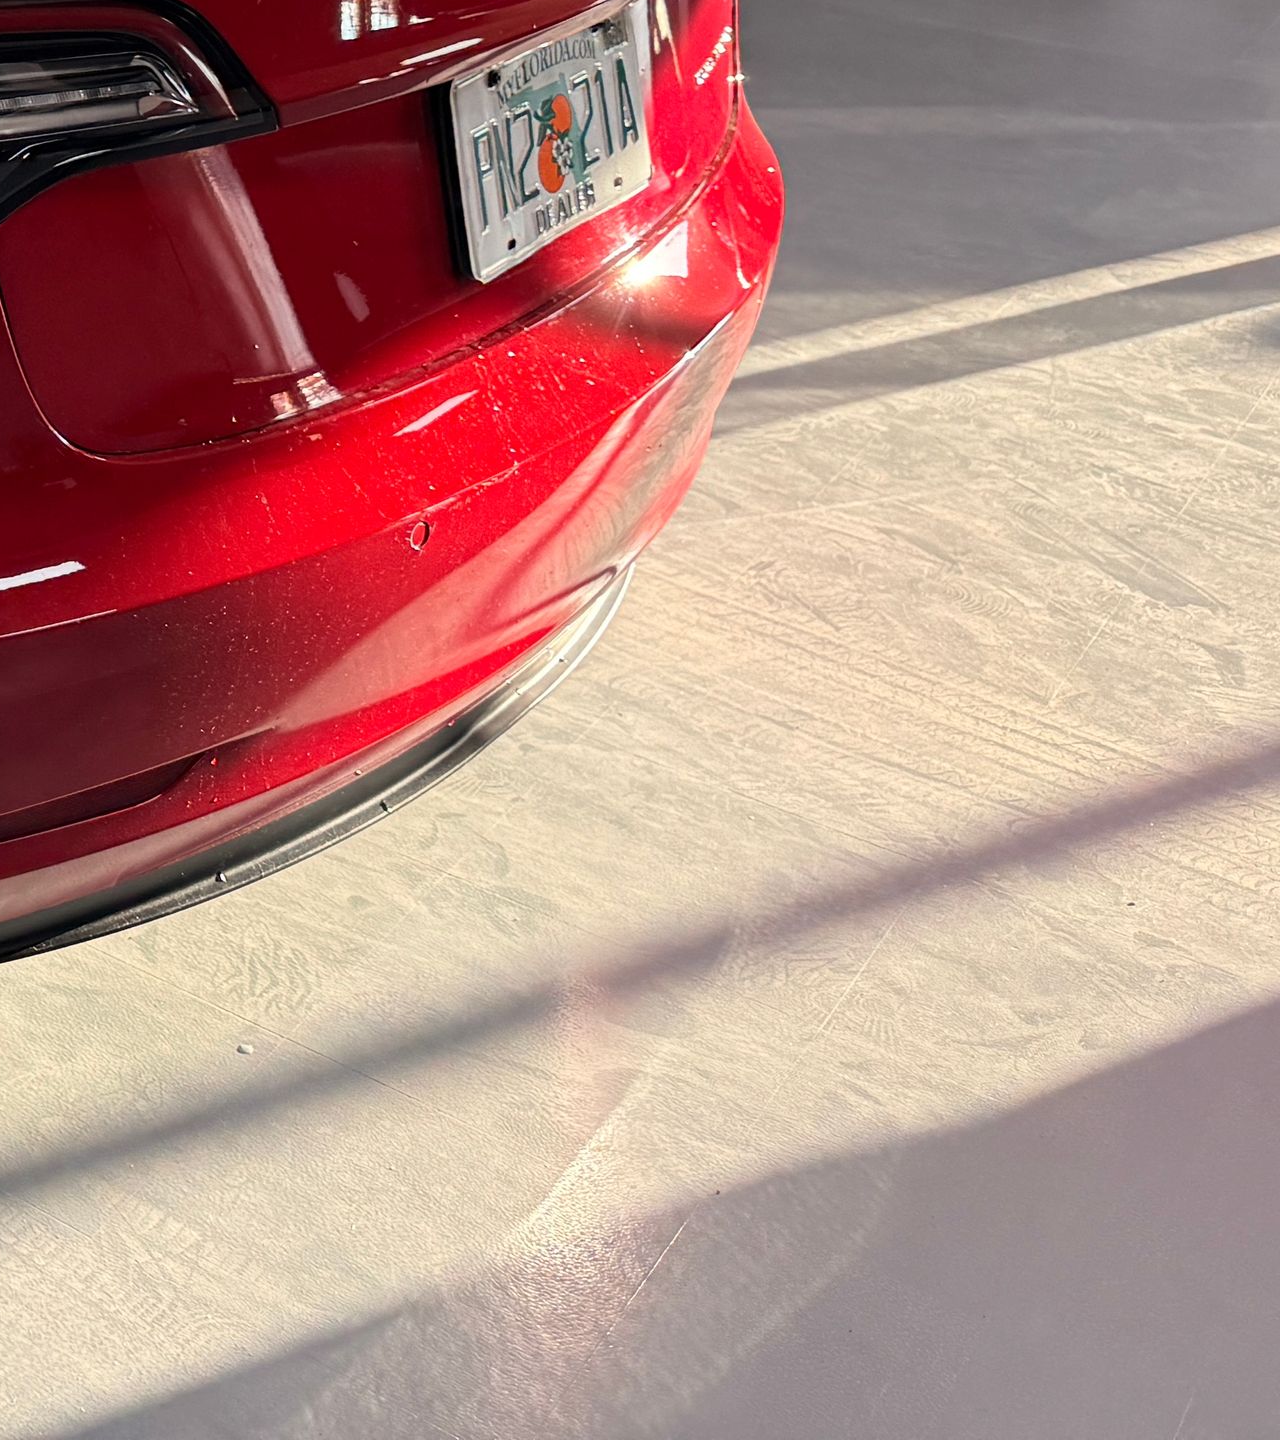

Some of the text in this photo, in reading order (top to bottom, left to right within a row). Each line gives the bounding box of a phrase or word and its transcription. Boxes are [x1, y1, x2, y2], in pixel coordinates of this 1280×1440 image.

[496, 38, 596, 108] MYFLORIDA.COM
[471, 104, 540, 233] PN2
[570, 54, 640, 171] 21A
[535, 178, 596, 234] DEALER
